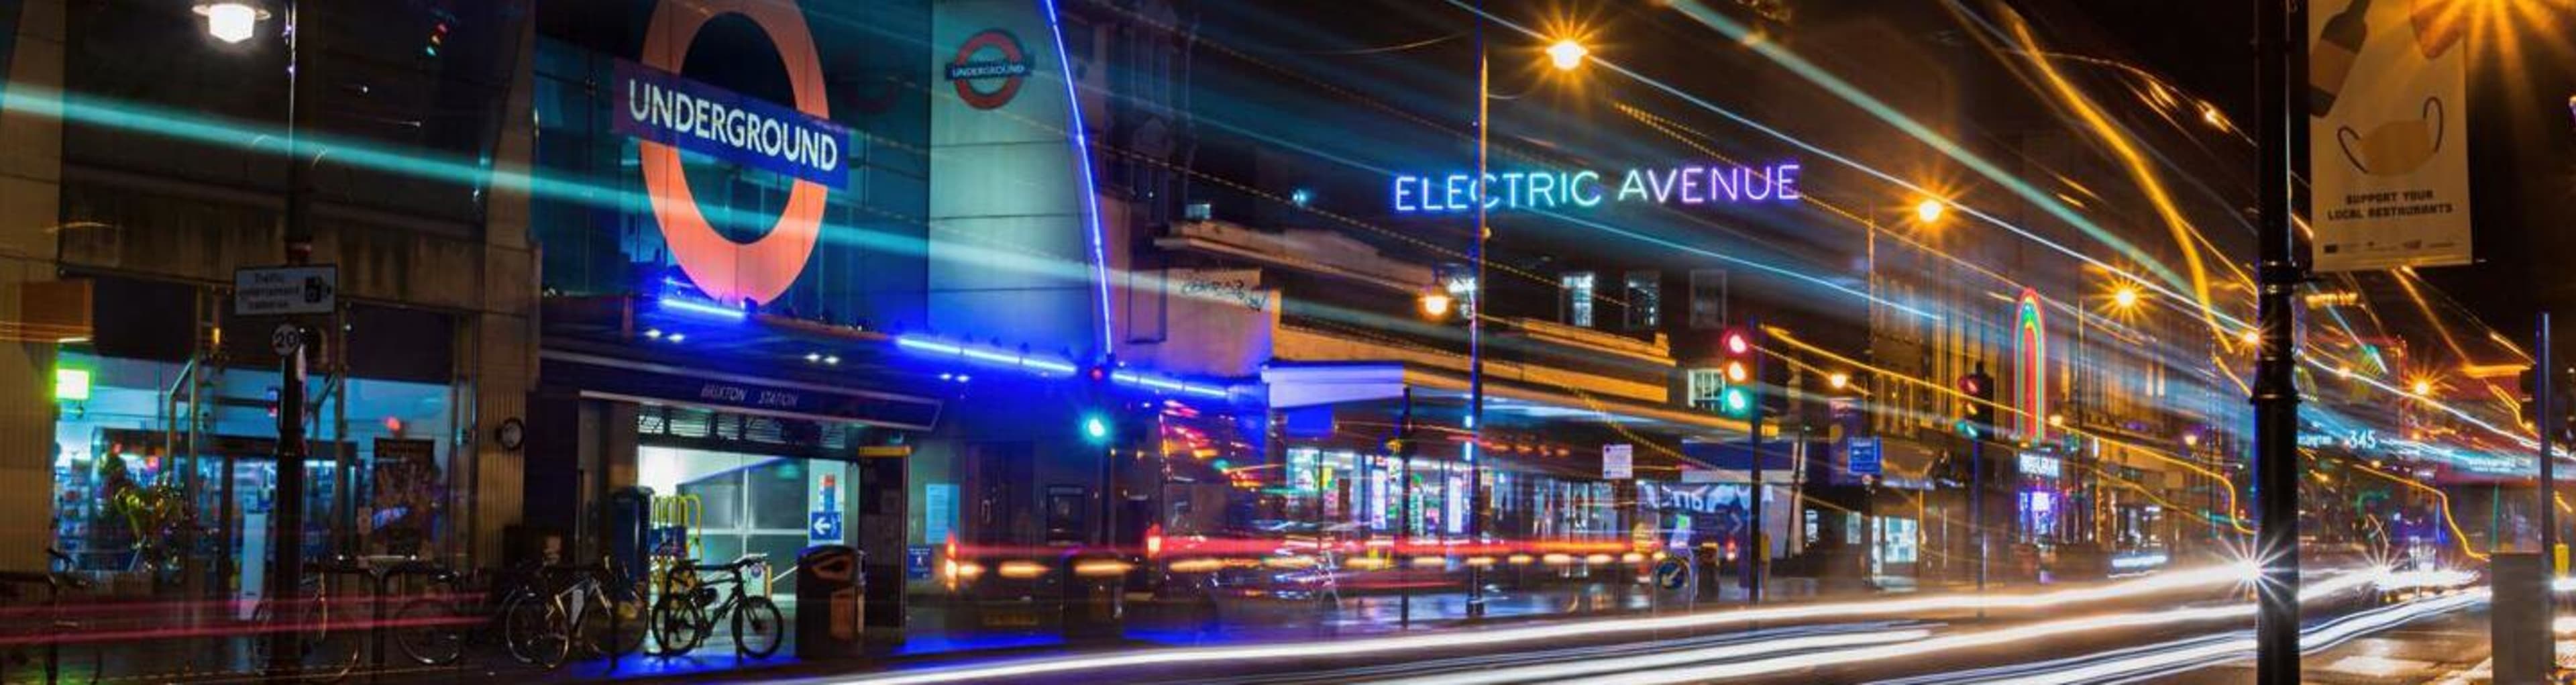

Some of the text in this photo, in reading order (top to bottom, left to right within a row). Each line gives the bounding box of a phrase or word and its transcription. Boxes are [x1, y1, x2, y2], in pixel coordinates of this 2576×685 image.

[953, 64, 1024, 77] UNDERGROUND
[629, 78, 838, 171] UNDERGROUND
[1395, 164, 1800, 211] ELECTRIC AVENUE
[2346, 190, 2433, 204] SUPPORT YOUR
[2327, 203, 2453, 220] LOCAL RESTAURANTS
[275, 331, 298, 348] 20
[2349, 429, 2376, 450] 345
